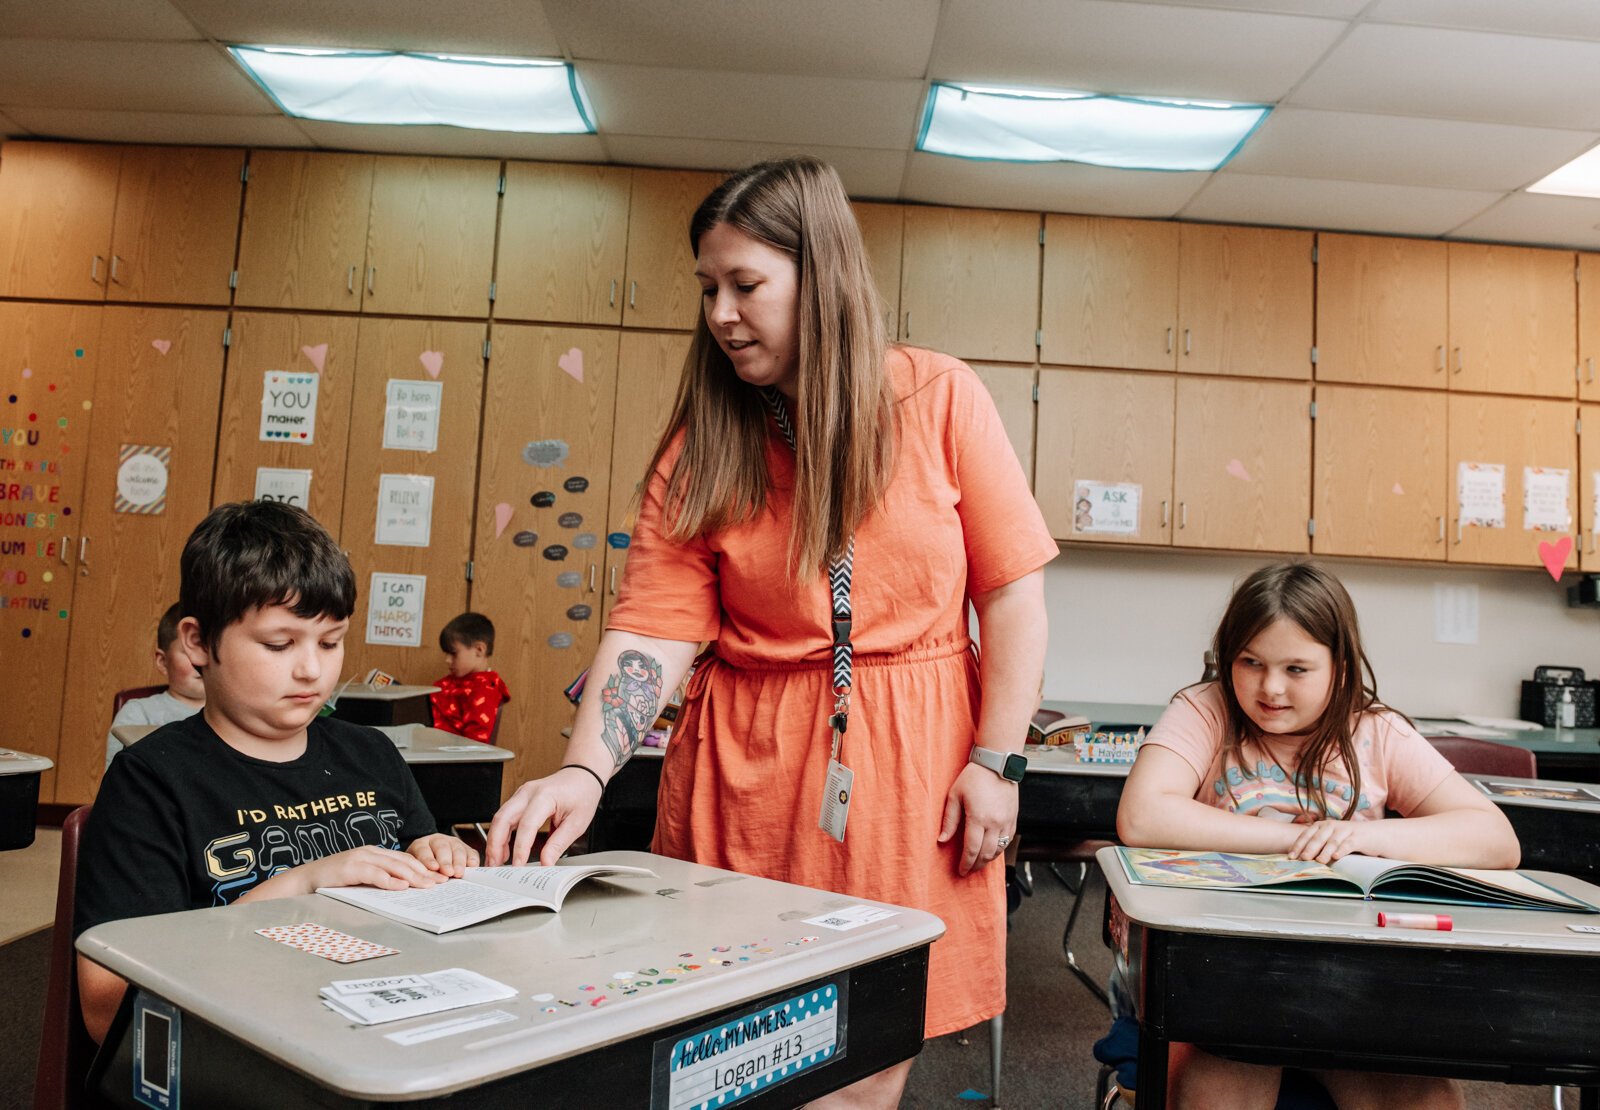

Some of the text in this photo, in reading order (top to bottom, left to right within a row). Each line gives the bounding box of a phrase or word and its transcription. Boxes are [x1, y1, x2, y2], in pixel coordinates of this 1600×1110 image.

[269, 390, 310, 409] YOU
[1, 429, 39, 446] YOU
[0, 483, 60, 503] BRAVE
[1102, 490, 1128, 503] ASK
[0, 512, 57, 529] ONEST
[388, 596, 405, 607] DO
[237, 791, 377, 825] I'D RATHER BE
[725, 1030, 741, 1051] MY
[742, 1017, 772, 1043] NAME
[714, 1034, 803, 1091] Logan #13
